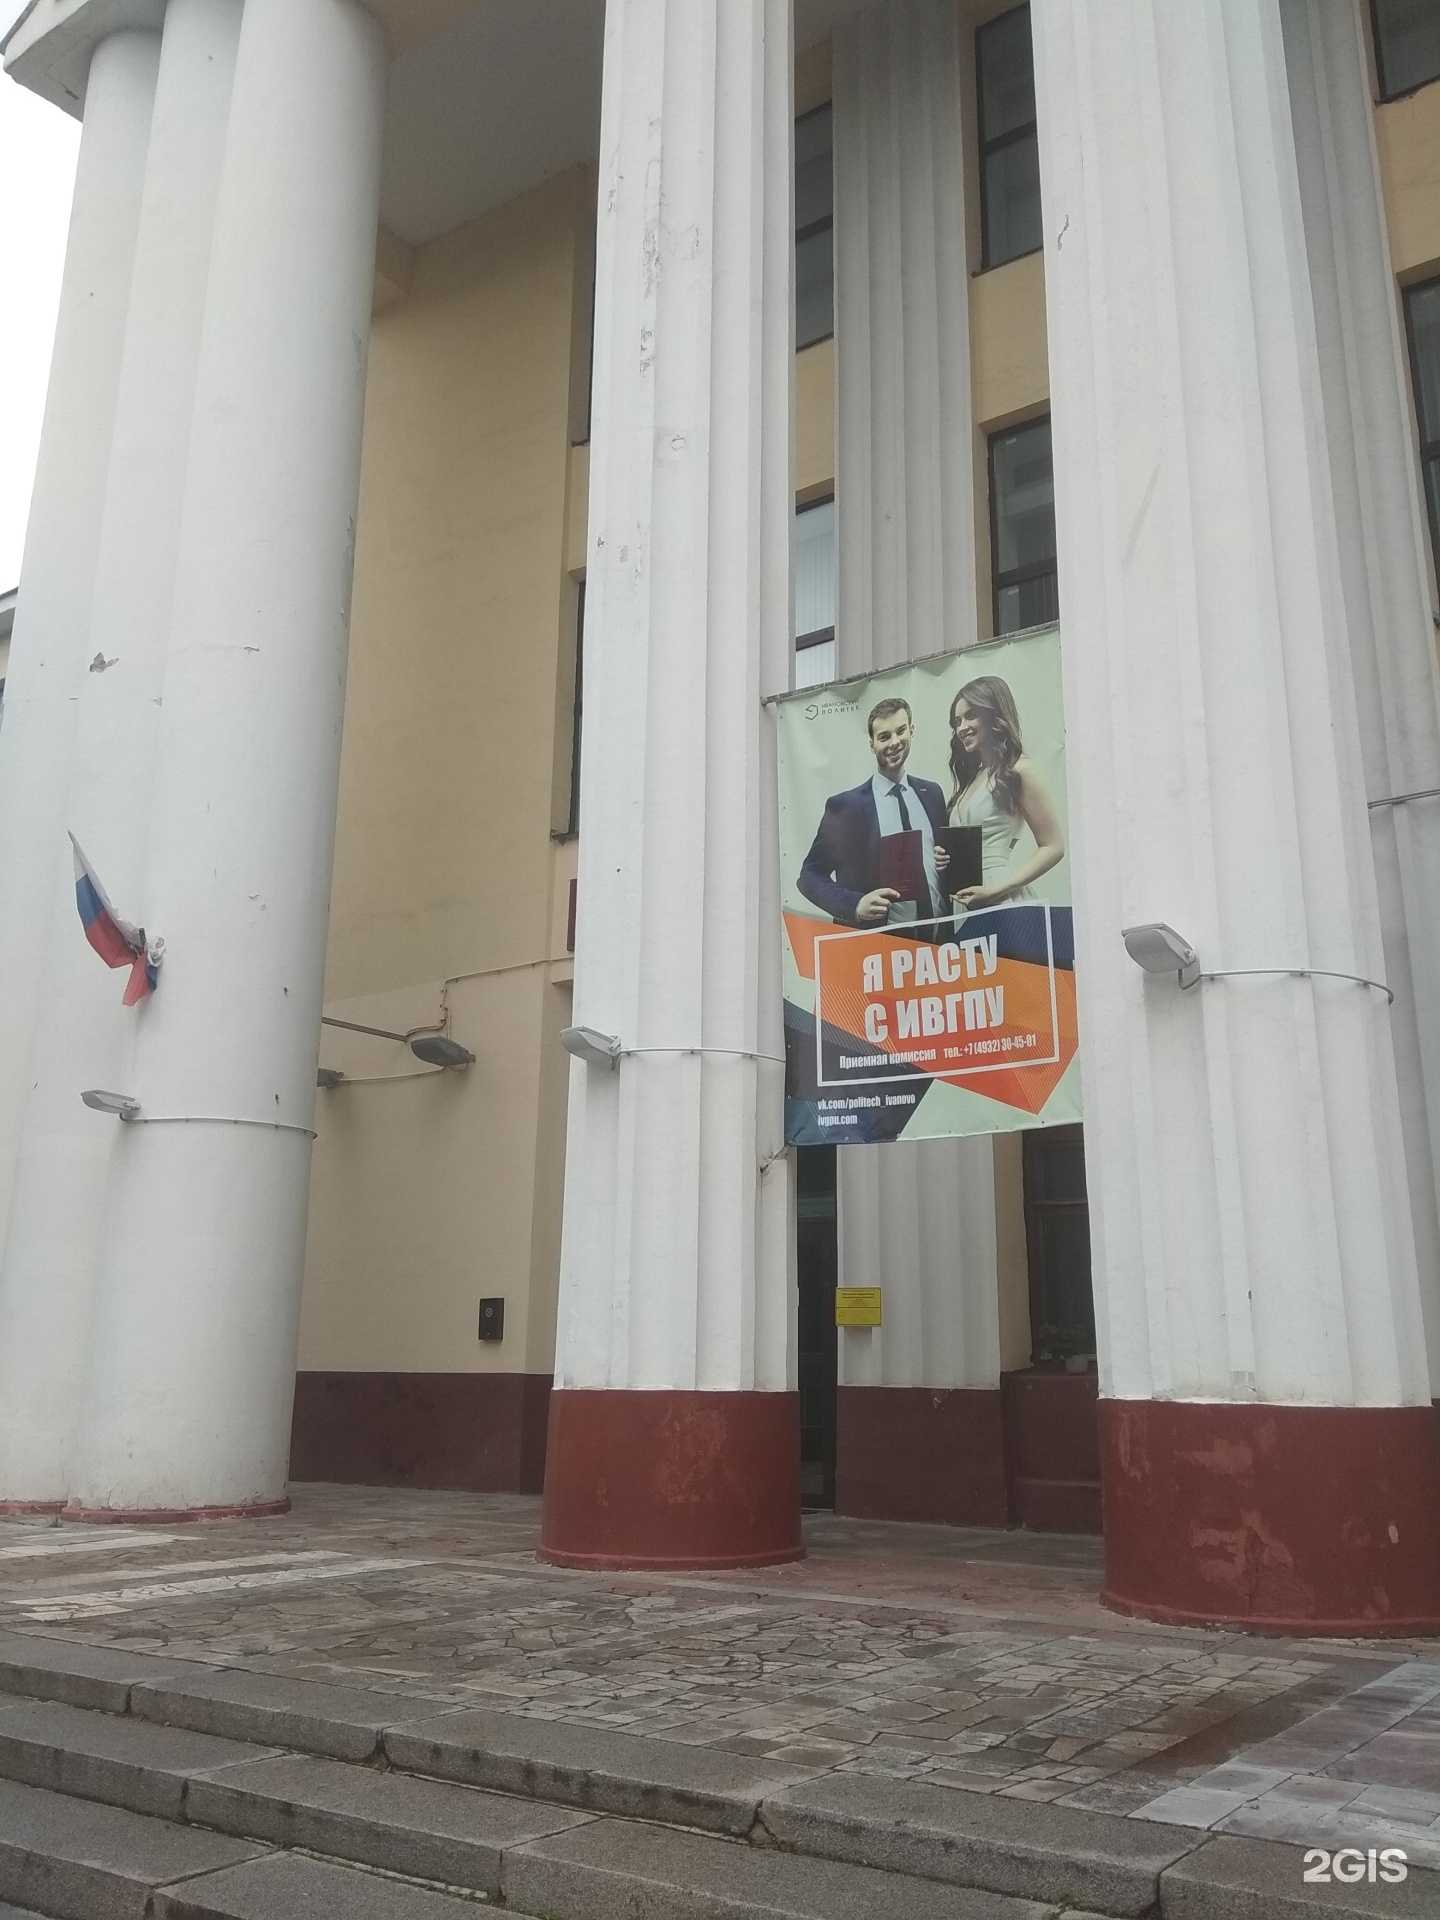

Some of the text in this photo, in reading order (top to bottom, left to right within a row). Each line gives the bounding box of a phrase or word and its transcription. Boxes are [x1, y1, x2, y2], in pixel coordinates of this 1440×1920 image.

[862, 933, 999, 993] Я РАСТУ
[864, 985, 1005, 1043] С ИВГПУ
[839, 1054, 888, 1070] Приемная
[889, 1048, 937, 1065] комиссия
[974, 1039, 1000, 1055] (4932)
[817, 1094, 916, 1110] vk.com/politech_ivanovo
[817, 1114, 858, 1127] ivgpu.com
